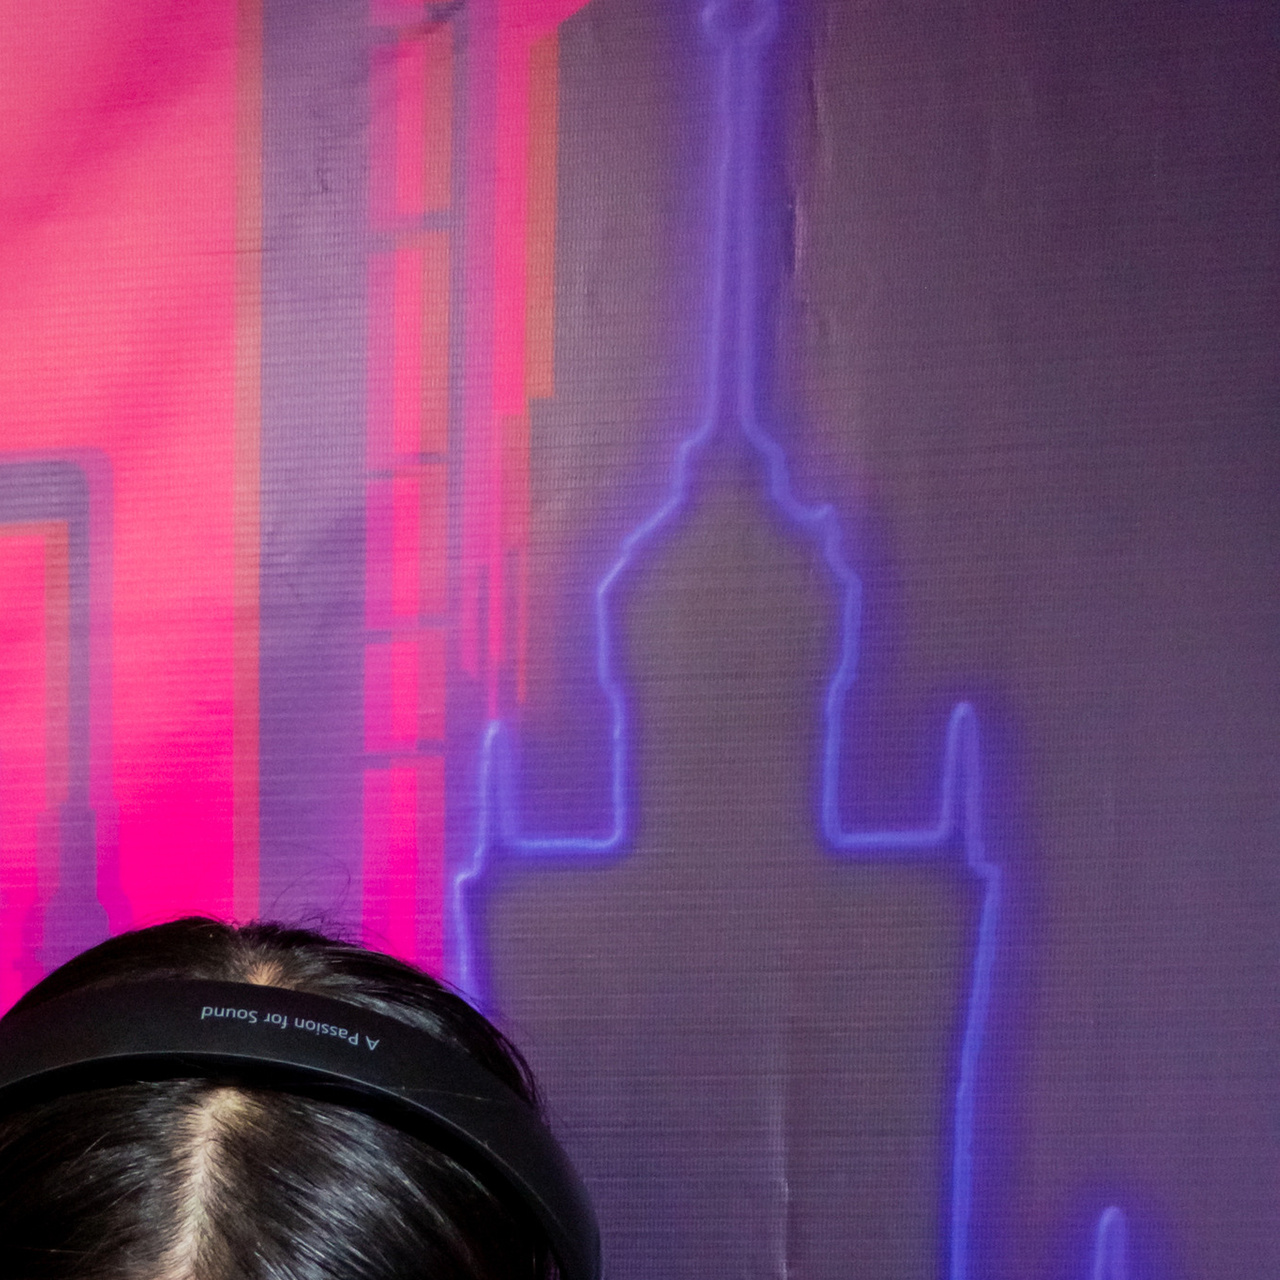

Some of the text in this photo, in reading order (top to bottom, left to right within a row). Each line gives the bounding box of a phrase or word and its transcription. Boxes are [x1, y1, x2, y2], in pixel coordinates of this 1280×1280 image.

[201, 1006, 380, 1051] A Passion for Sound
